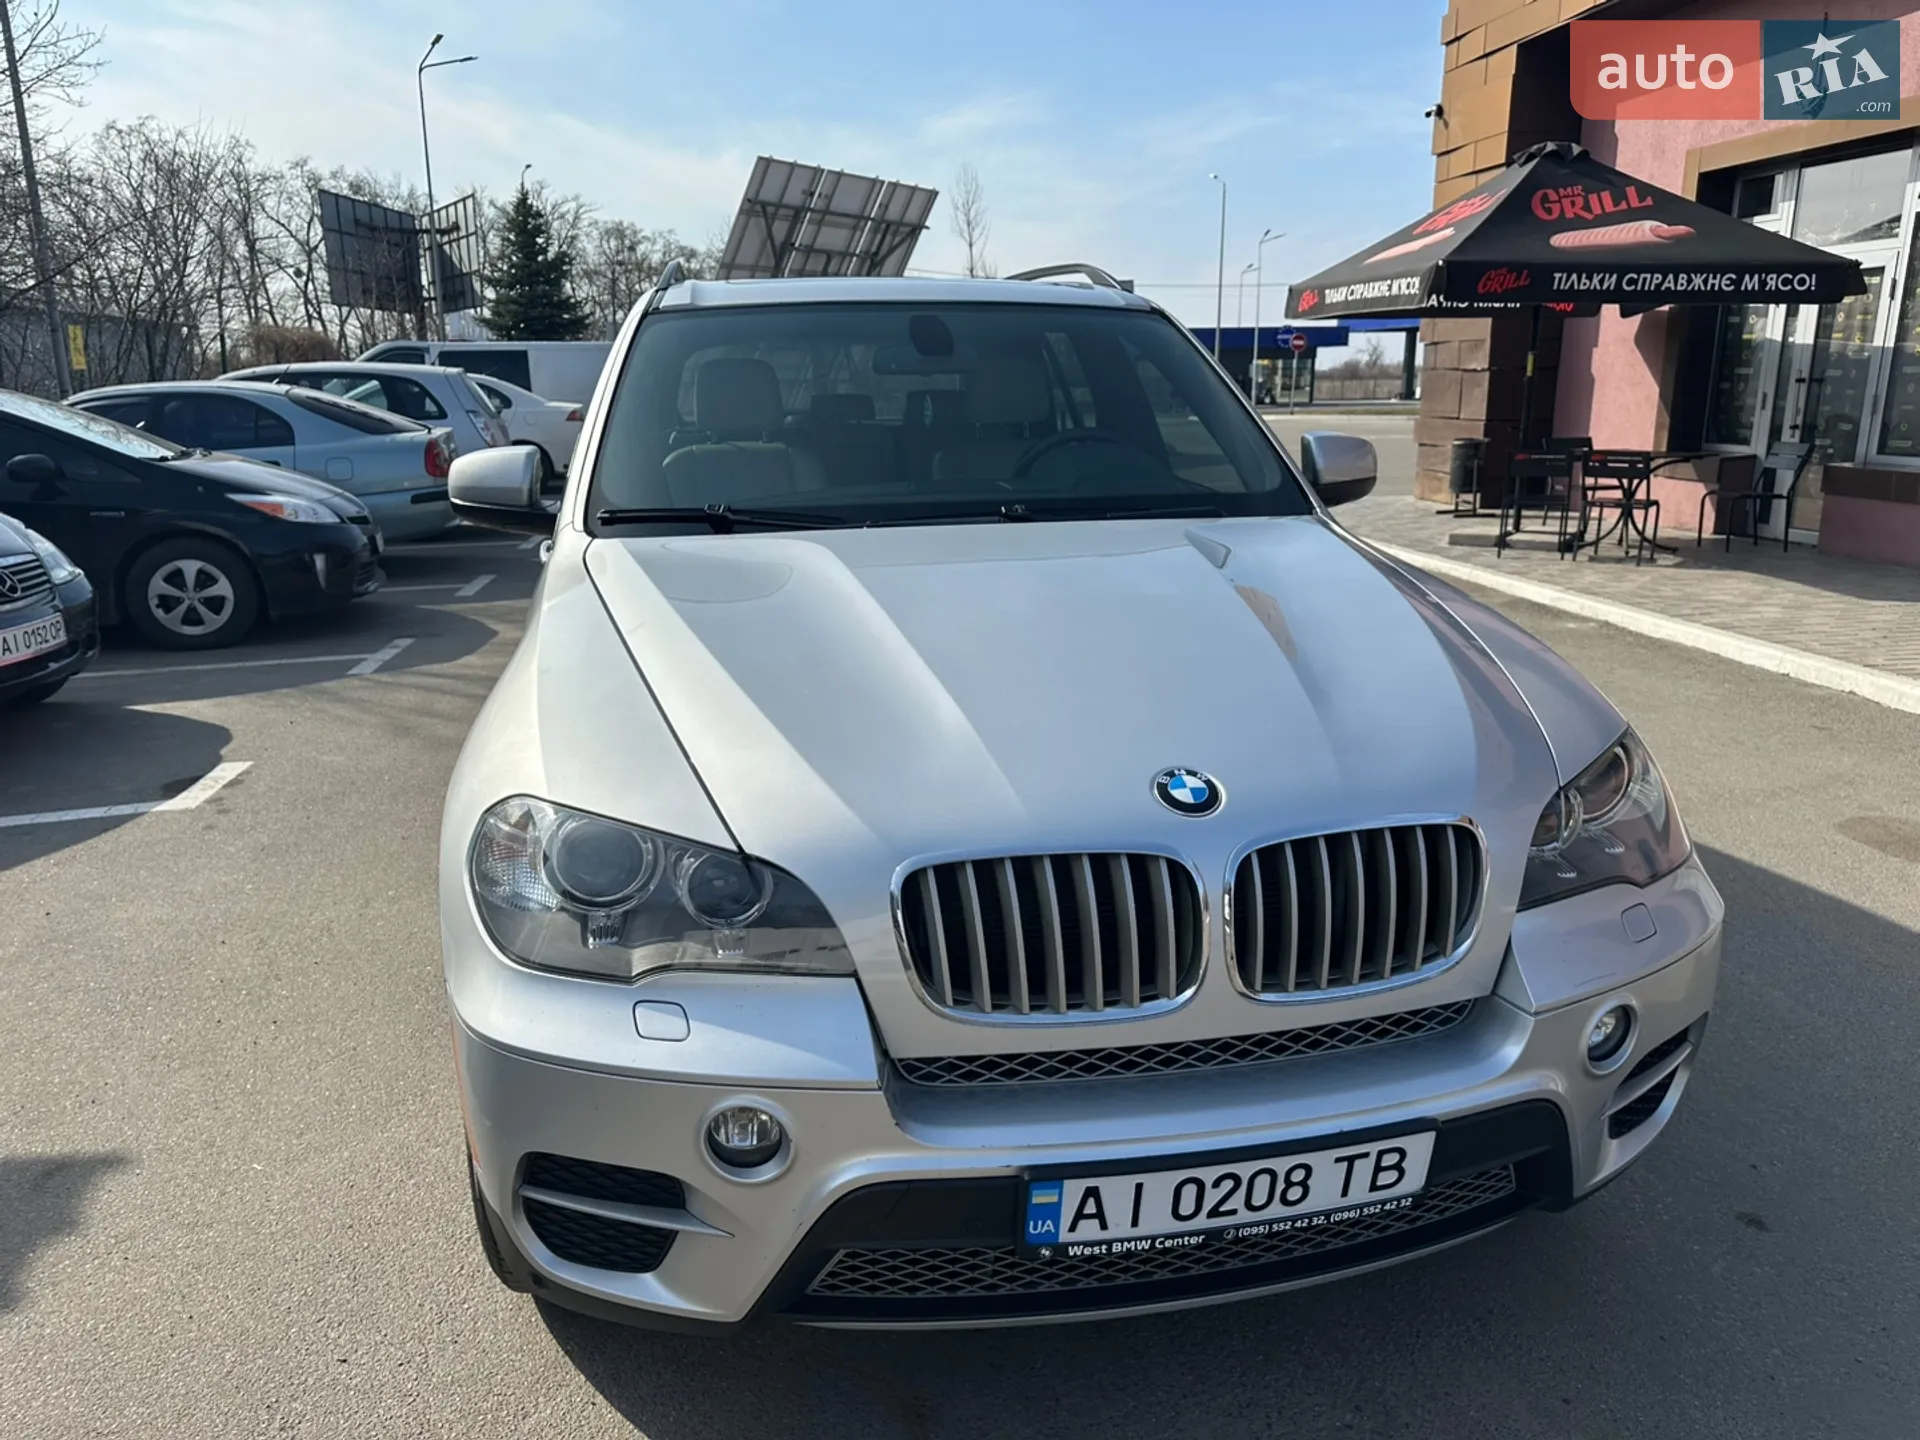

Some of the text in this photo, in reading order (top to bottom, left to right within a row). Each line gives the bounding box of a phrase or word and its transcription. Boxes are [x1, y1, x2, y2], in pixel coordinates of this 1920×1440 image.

[1531, 185, 1654, 221] GRILL
[1558, 185, 1585, 197] MR
[1477, 269, 1531, 295] GRILL
[1552, 272, 1618, 291] ТІЛЬКИ
[1622, 272, 1737, 291] СПРАВЖНЄ
[23, 625, 50, 649] 0152
[1171, 1163, 1313, 1222] 0208
[1334, 1146, 1407, 1198] TB
[1029, 1220, 1055, 1234] UA
[1238, 1224, 1269, 1238] (095)
[1271, 1220, 1292, 1232] 552
[1295, 1218, 1308, 1228] 42
[1330, 1209, 1360, 1223] (096)
[1362, 1204, 1381, 1216] 552
[1383, 1200, 1397, 1211] 42
[1399, 1197, 1413, 1208] 32
[1068, 1235, 1205, 1256] West BMW Center
